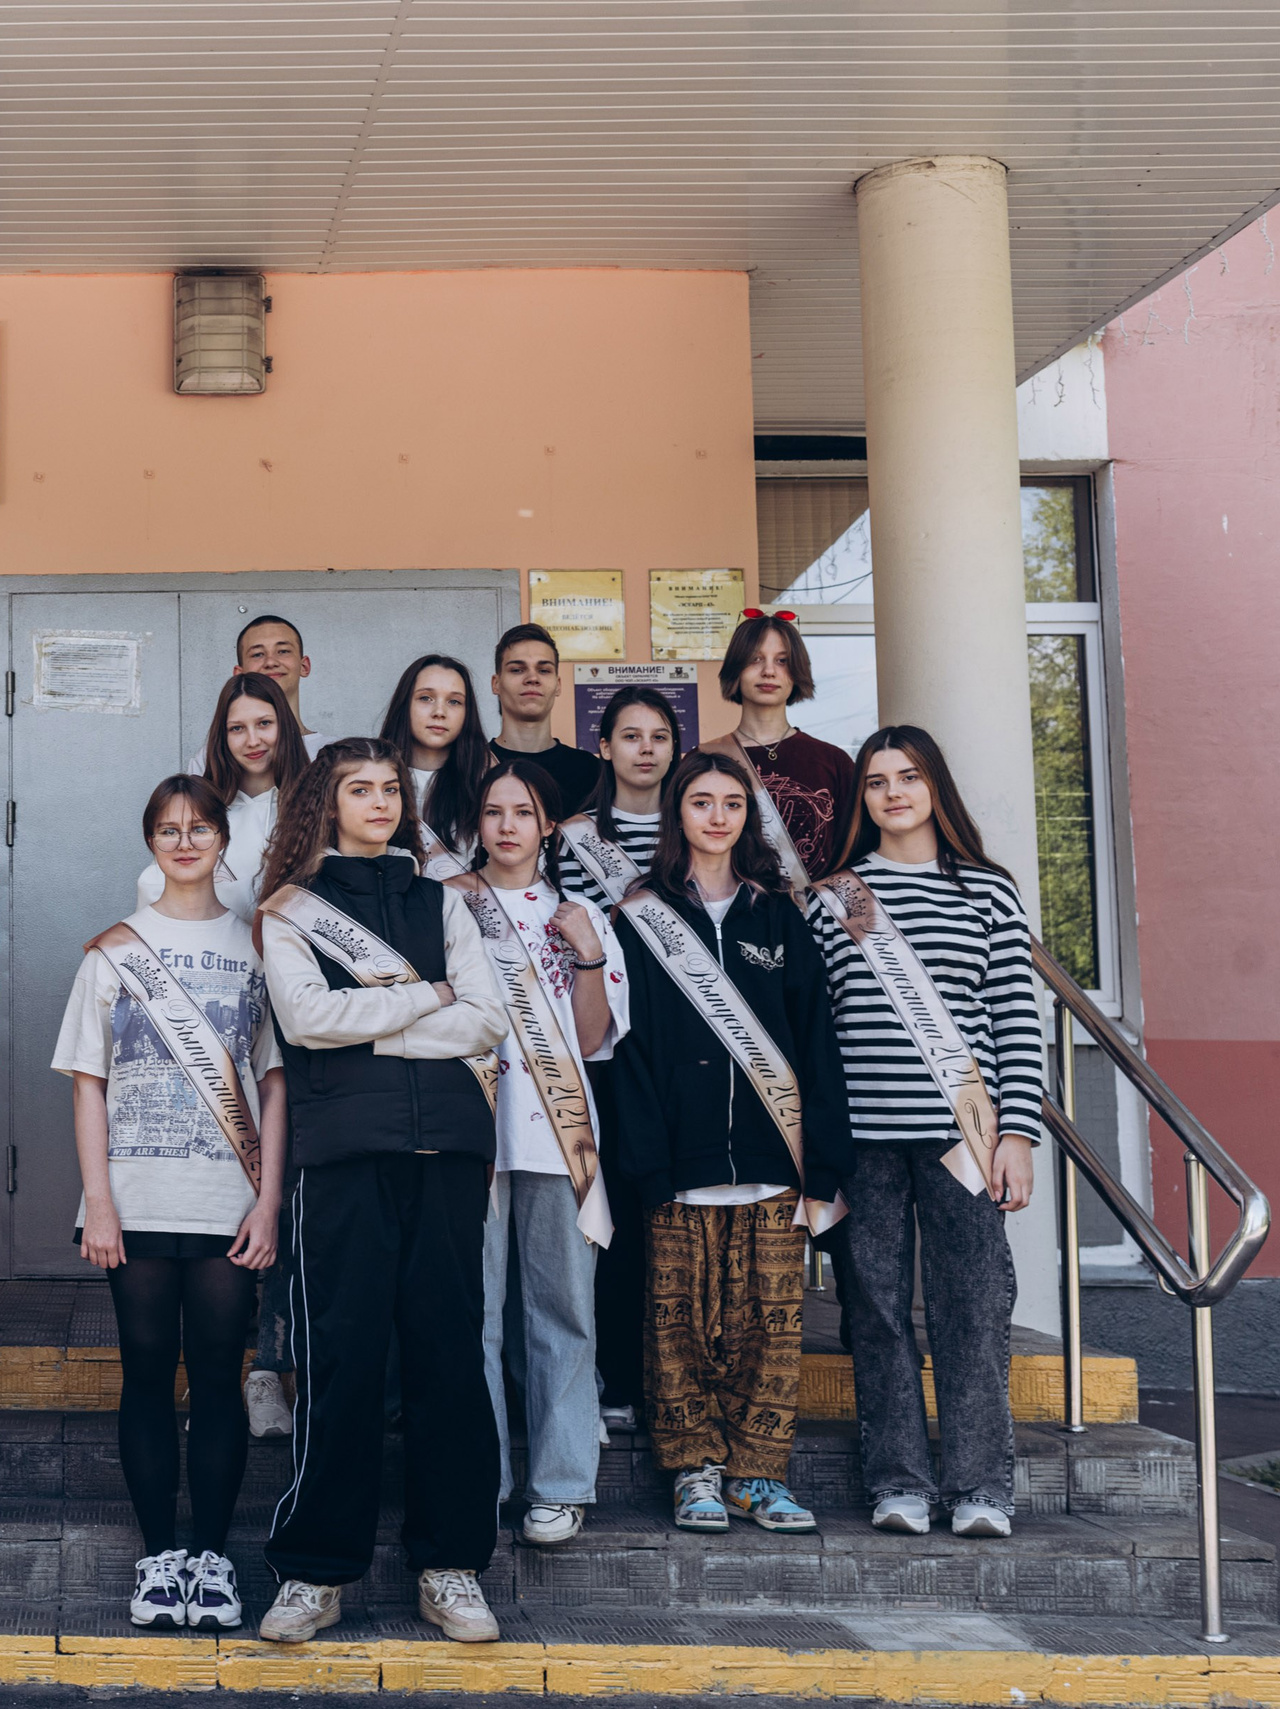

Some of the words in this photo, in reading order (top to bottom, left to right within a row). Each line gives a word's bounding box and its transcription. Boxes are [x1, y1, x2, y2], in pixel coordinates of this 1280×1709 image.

[542, 598, 613, 607] ВНИМАНИЕ!
[608, 666, 664, 674] ВНИМАНИЕ!
[201, 950, 247, 973] Time
[491, 938, 562, 1081] Выпускница
[546, 1082, 589, 1130] 2024
[680, 952, 774, 1084] Выпускница
[765, 1078, 804, 1128] 2024
[858, 914, 943, 1042] Выпускница
[928, 1040, 980, 1091] 2024
[160, 998, 249, 1135] Выпускница
[113, 1148, 132, 1156] WHO
[135, 1148, 155, 1156] ARE
